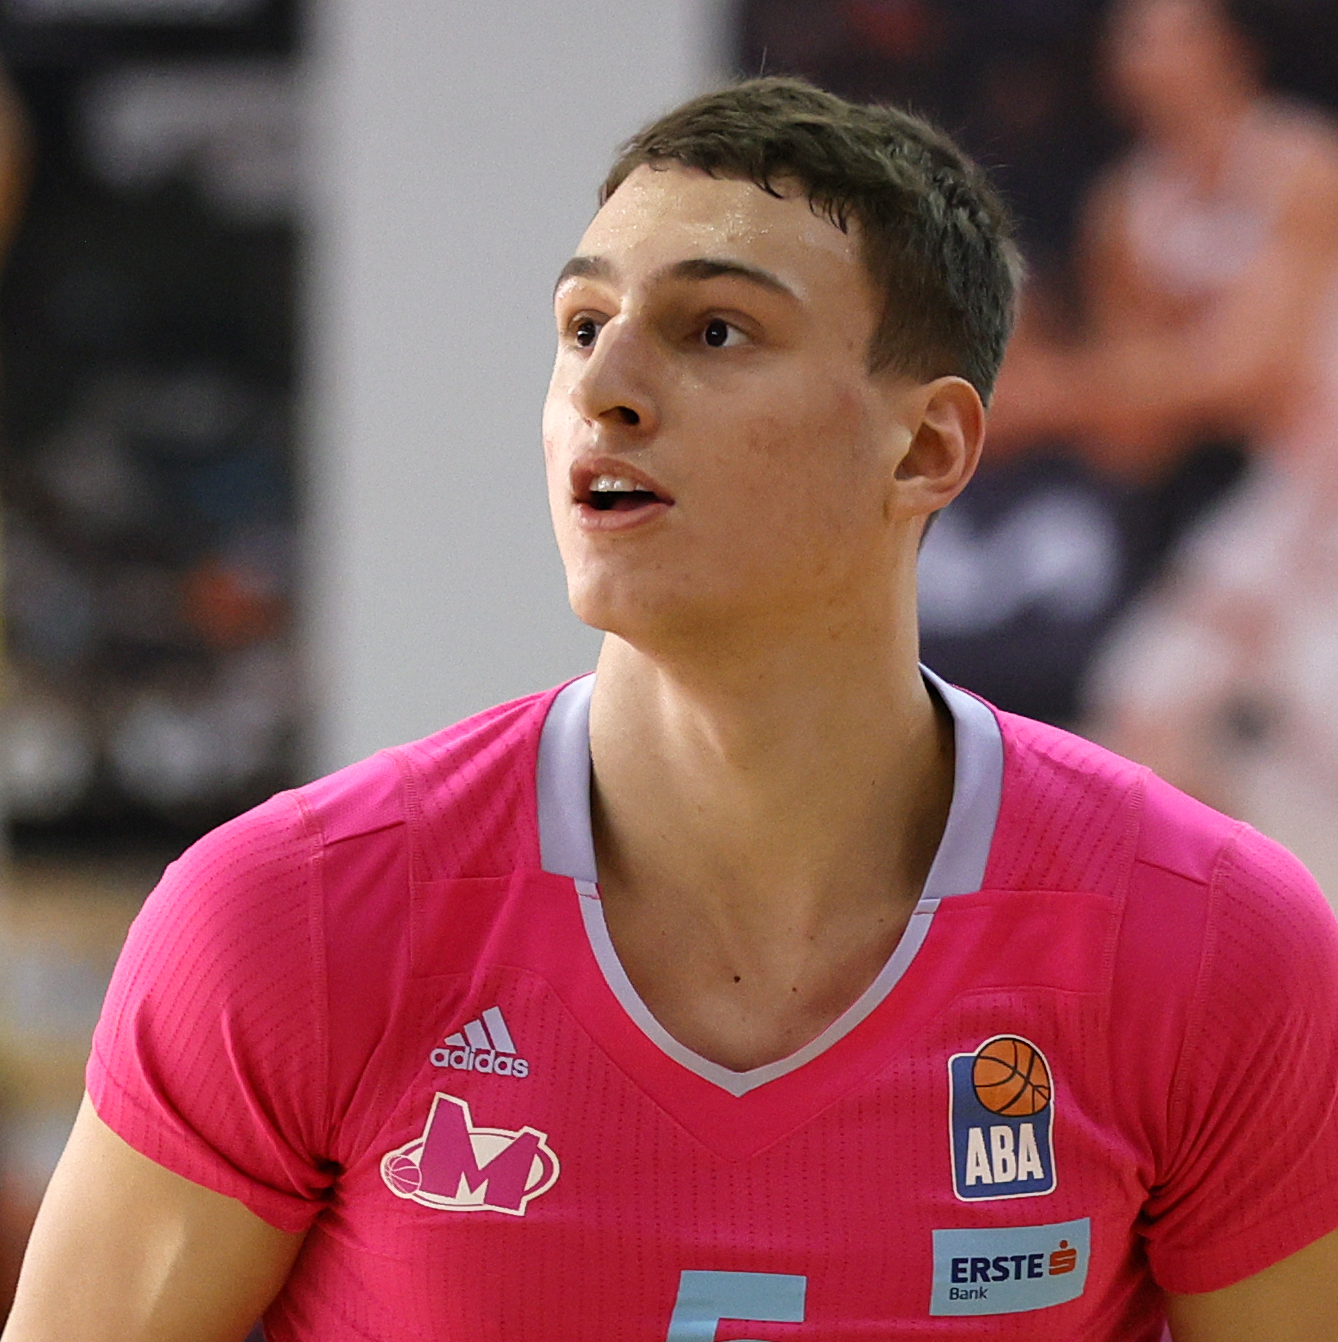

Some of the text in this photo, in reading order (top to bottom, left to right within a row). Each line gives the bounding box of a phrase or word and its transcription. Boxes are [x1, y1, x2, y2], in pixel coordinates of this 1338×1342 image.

[429, 1045, 530, 1079] adidas
[965, 1123, 1044, 1187] ABA
[951, 1252, 1045, 1284] ERSTE
[949, 1286, 989, 1301] Bank
